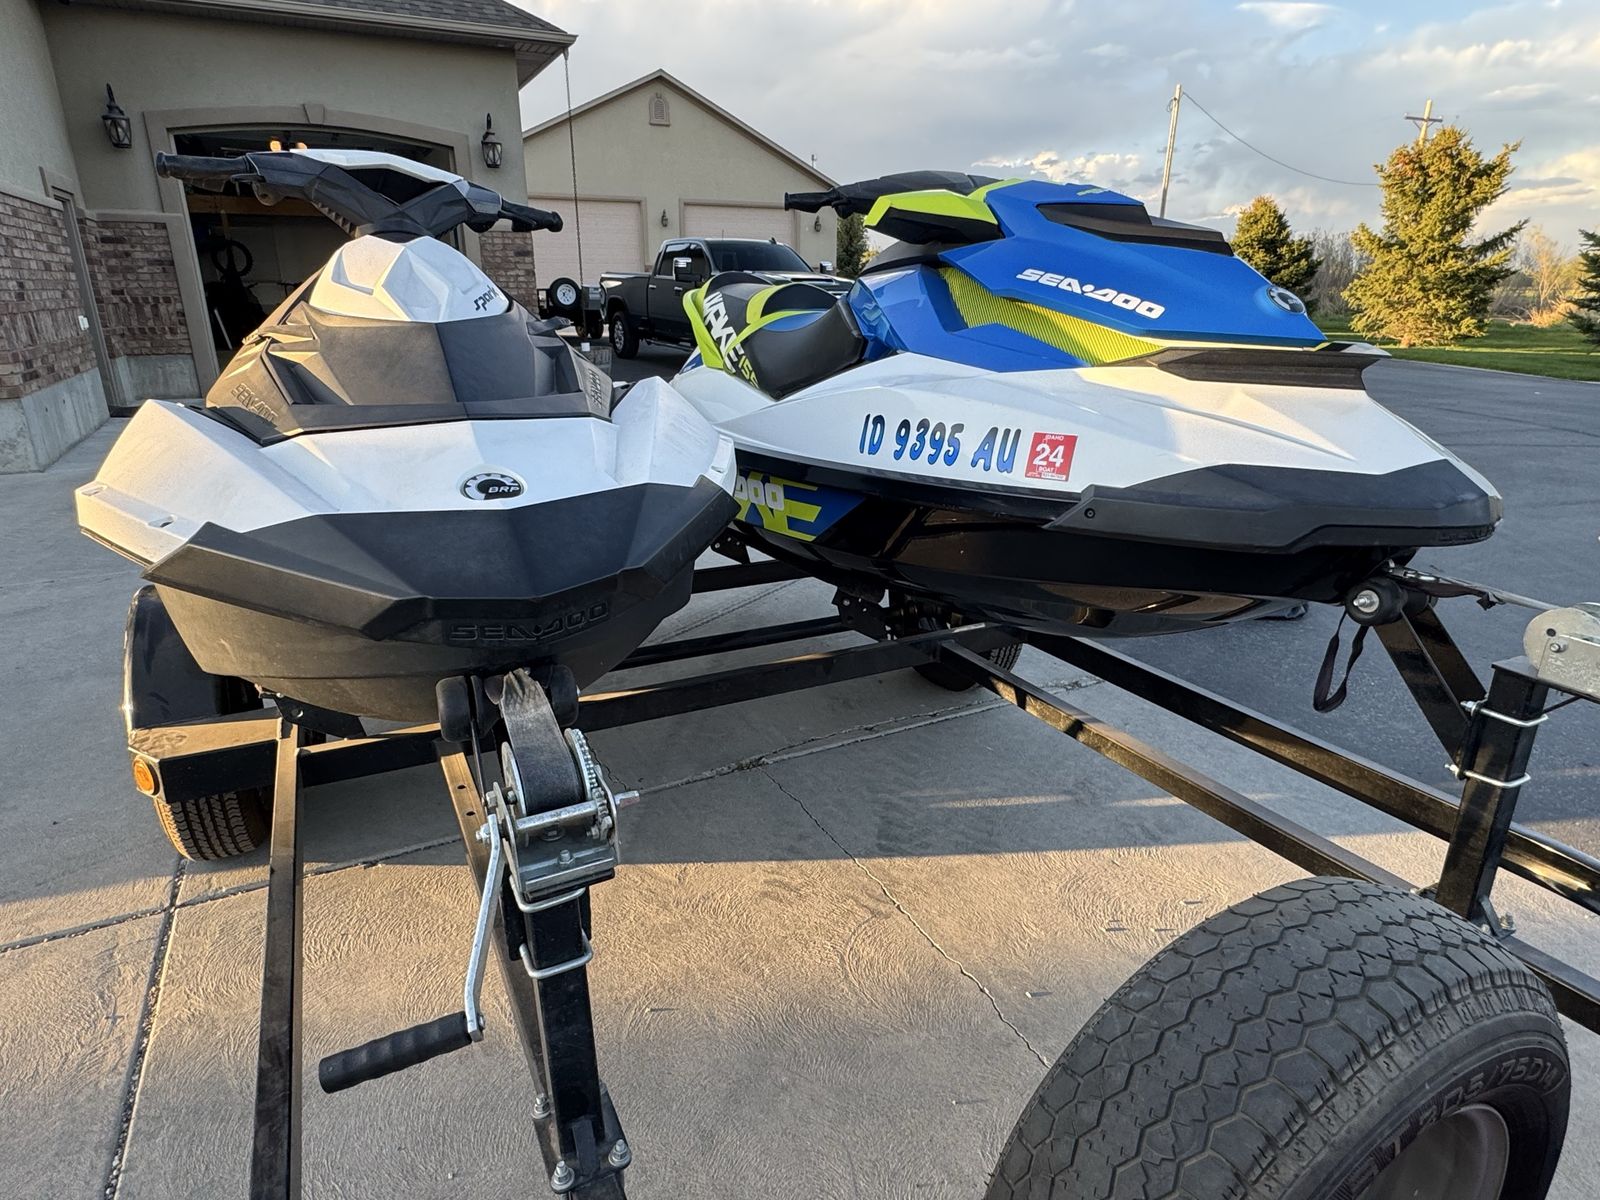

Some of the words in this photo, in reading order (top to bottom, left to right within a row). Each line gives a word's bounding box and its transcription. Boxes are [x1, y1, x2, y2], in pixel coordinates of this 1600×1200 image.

[703, 291, 745, 374] WAKE
[859, 413, 886, 455] ID
[893, 418, 964, 466] 9395
[971, 427, 1022, 474] AU
[1032, 443, 1065, 467] 24
[488, 485, 520, 494] BRP
